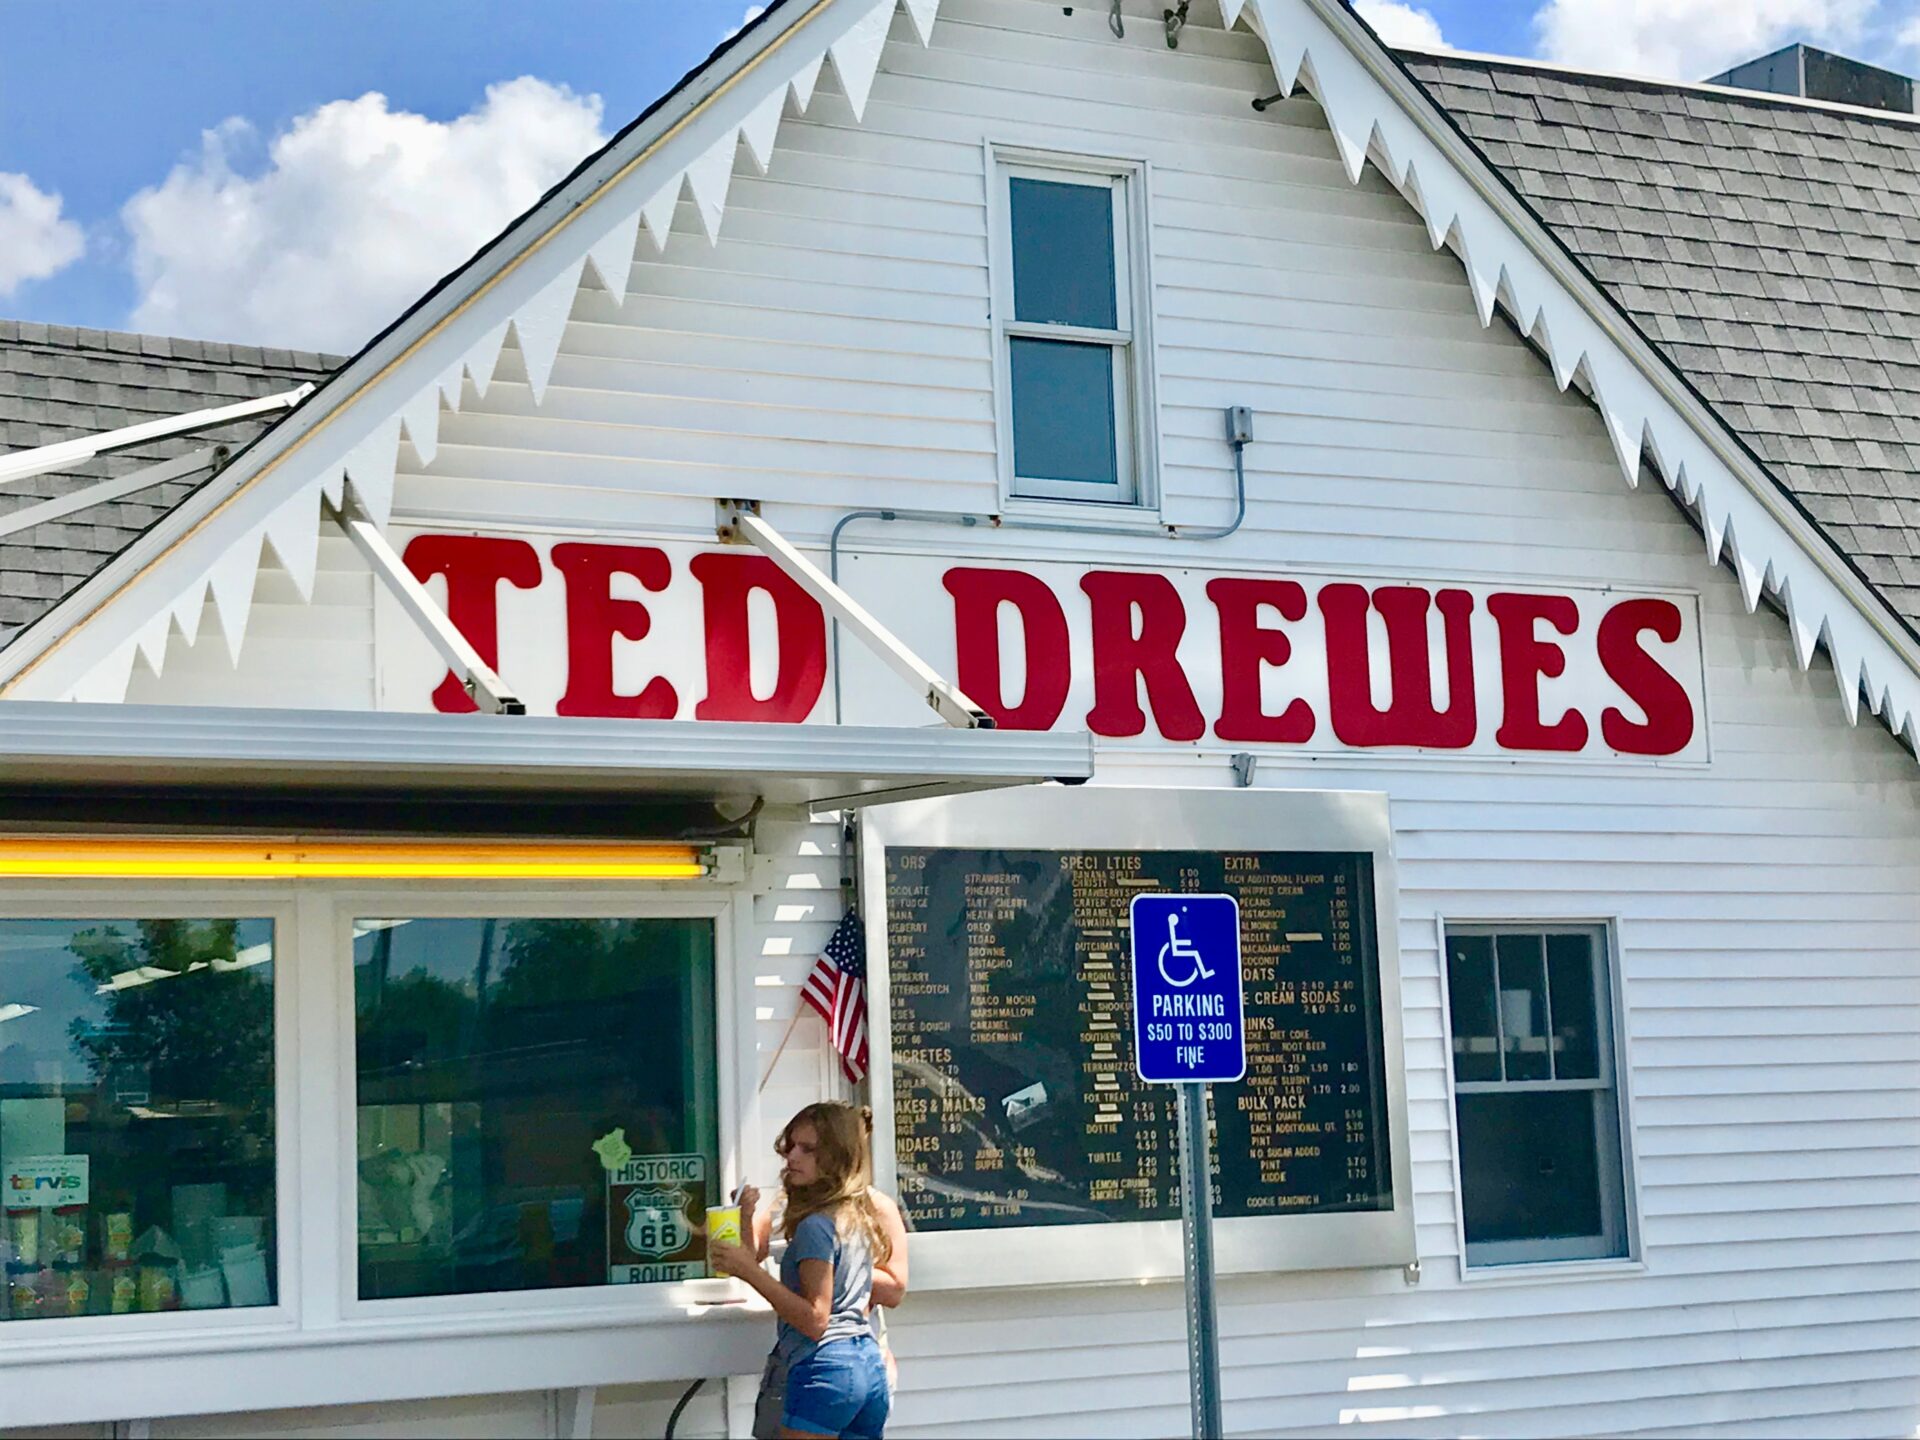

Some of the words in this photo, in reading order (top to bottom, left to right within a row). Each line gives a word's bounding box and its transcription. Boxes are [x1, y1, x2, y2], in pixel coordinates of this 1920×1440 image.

[403, 535, 827, 723] TED
[942, 566, 1694, 755] DREWES
[1224, 857, 1260, 870] EXTRA
[1224, 875, 1244, 884] EACH
[965, 886, 1010, 896] PINEAPPLE
[967, 922, 991, 932] OREO
[1242, 956, 1280, 966] COCONUT
[1243, 968, 1276, 981] OATS
[1006, 995, 1037, 1005] MOCHA
[1255, 991, 1294, 1005] CREAM
[1301, 991, 1341, 1003] SODAS
[1153, 994, 1225, 1017] PARKING
[1147, 1023, 1173, 1041] $50
[1177, 1023, 1193, 1041] TO
[1199, 1022, 1232, 1041] $300
[1176, 1046, 1205, 1064] FINE
[1238, 1097, 1268, 1110] BULK
[1274, 1096, 1306, 1109] PACK
[1251, 1136, 1271, 1146] PINT
[1088, 1152, 1122, 1163] TURTLE
[617, 1160, 697, 1181] HISTORIC
[1261, 1160, 1280, 1170] PINT
[9, 1172, 81, 1190] tervis
[641, 1224, 676, 1248] 66
[630, 1265, 687, 1282] ROUTE
